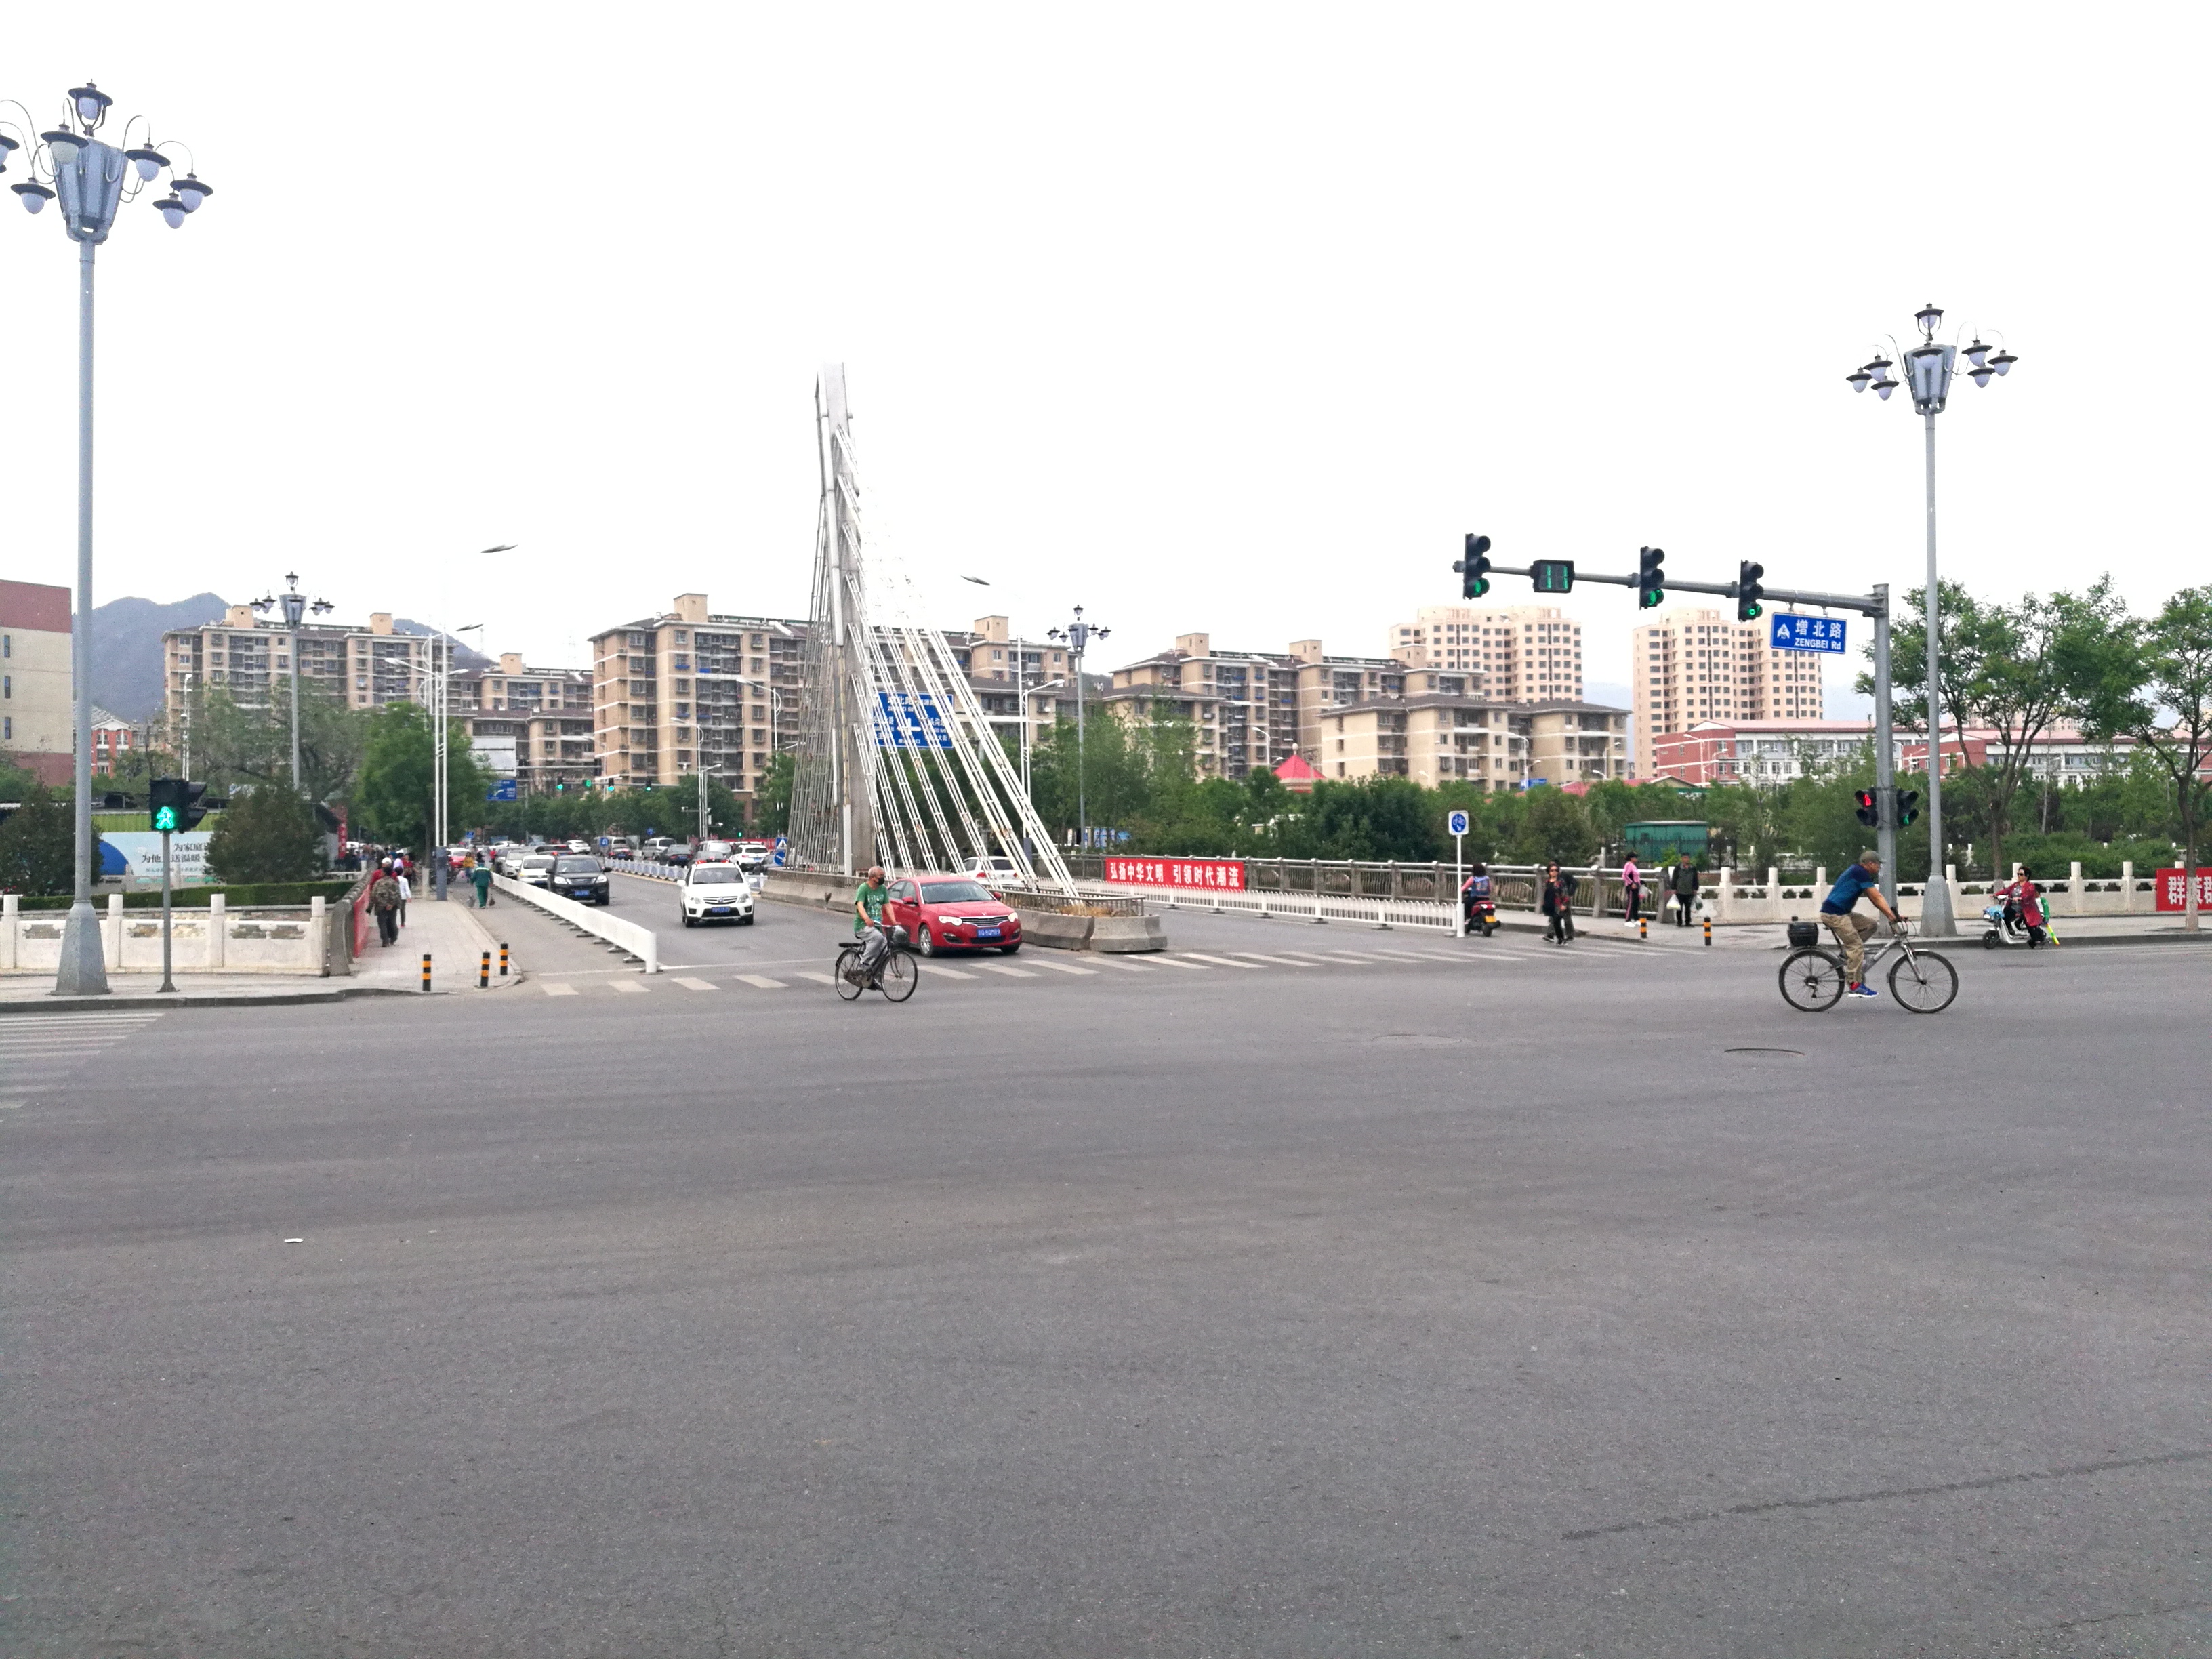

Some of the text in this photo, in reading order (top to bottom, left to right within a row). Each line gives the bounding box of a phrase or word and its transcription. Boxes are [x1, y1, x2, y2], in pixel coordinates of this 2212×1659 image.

[1795, 619, 1842, 638] 增北路
[1794, 638, 1841, 649] ZENGBEI Rd
[142, 853, 201, 863] 为他送温暖
[1110, 862, 1240, 887] 弘扬中华文明 引领时代潮流
